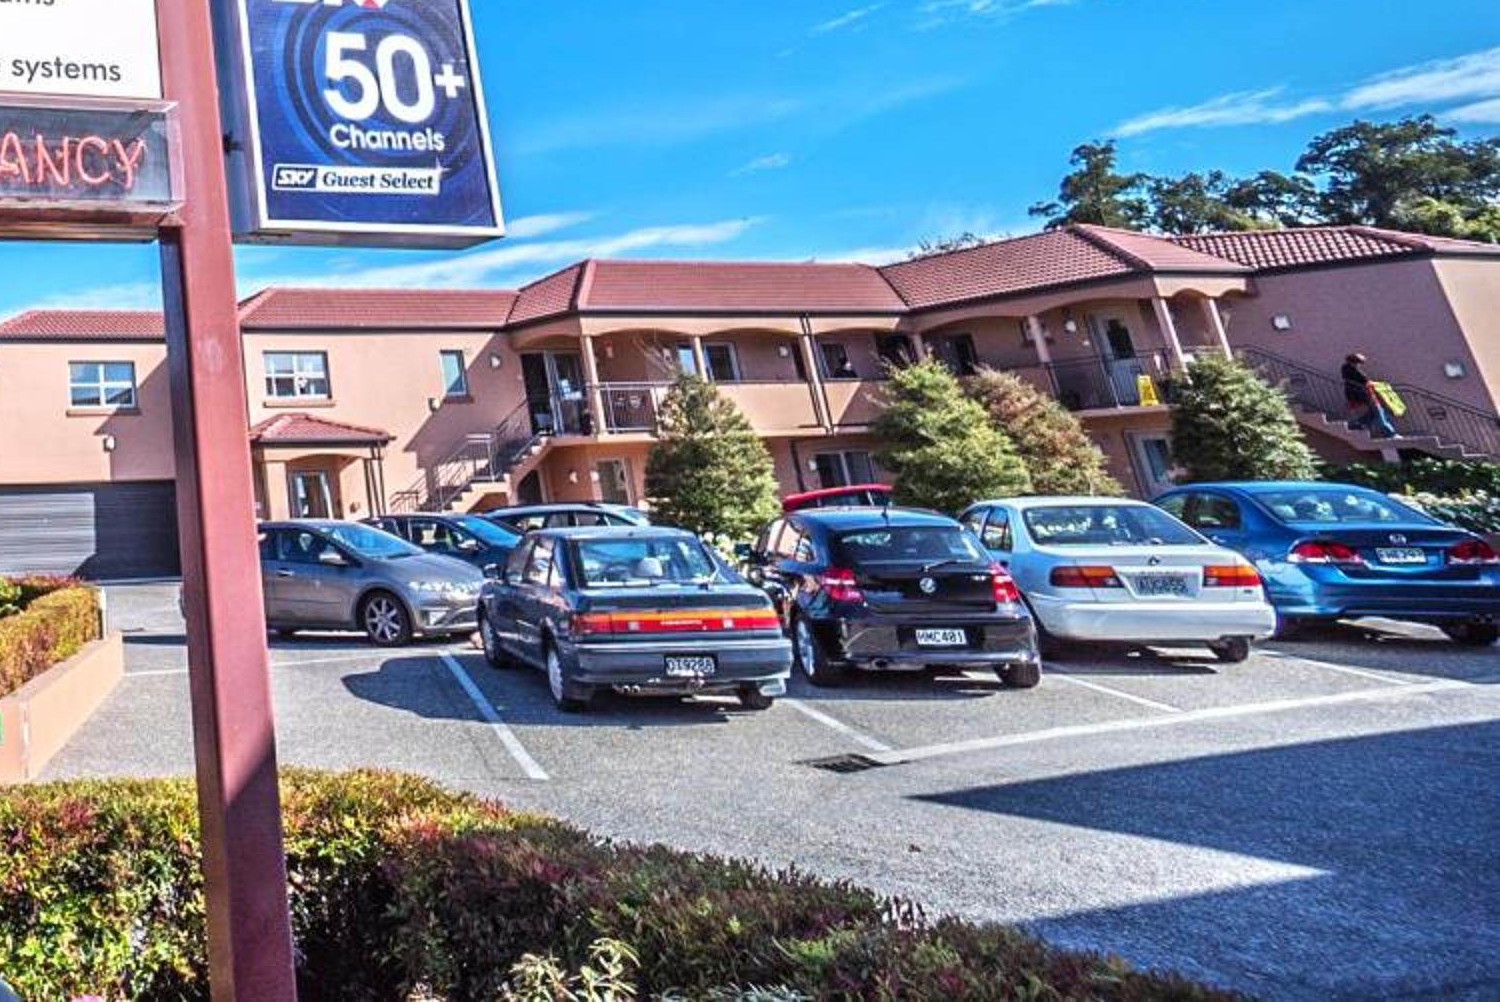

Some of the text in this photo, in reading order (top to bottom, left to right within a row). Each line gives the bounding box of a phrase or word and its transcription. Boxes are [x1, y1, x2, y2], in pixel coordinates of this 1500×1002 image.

[11, 56, 122, 84] systems
[323, 31, 466, 124] 50+
[329, 124, 446, 151] Channels
[276, 169, 435, 190] SKY Guest Select
